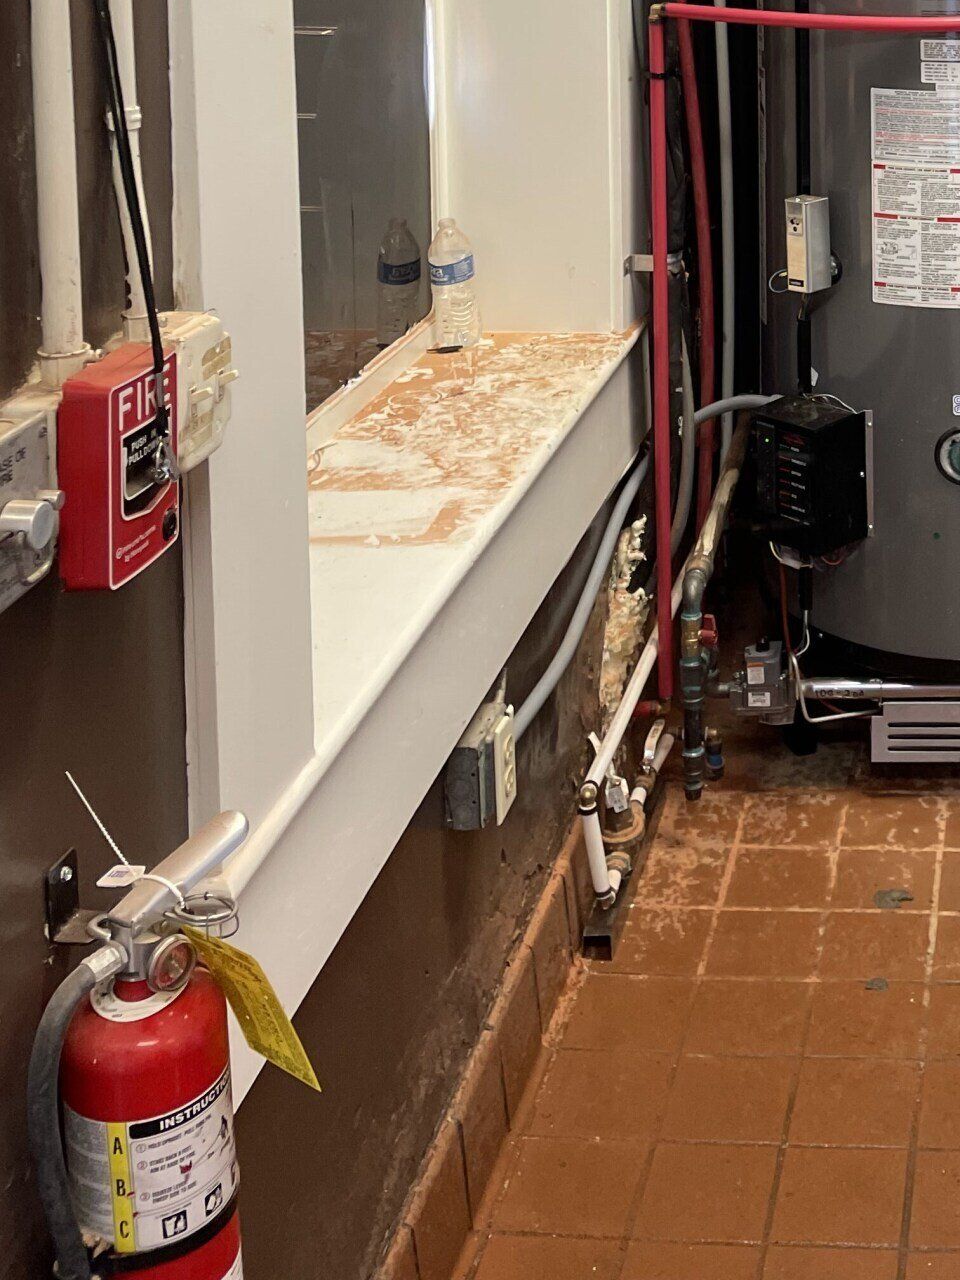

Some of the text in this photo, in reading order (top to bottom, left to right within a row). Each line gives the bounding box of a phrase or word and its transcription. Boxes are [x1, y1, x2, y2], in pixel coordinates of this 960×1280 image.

[131, 435, 148, 452] PUSH
[113, 1136, 123, 1155] A
[116, 1179, 126, 1197] B
[120, 1220, 129, 1239] C
